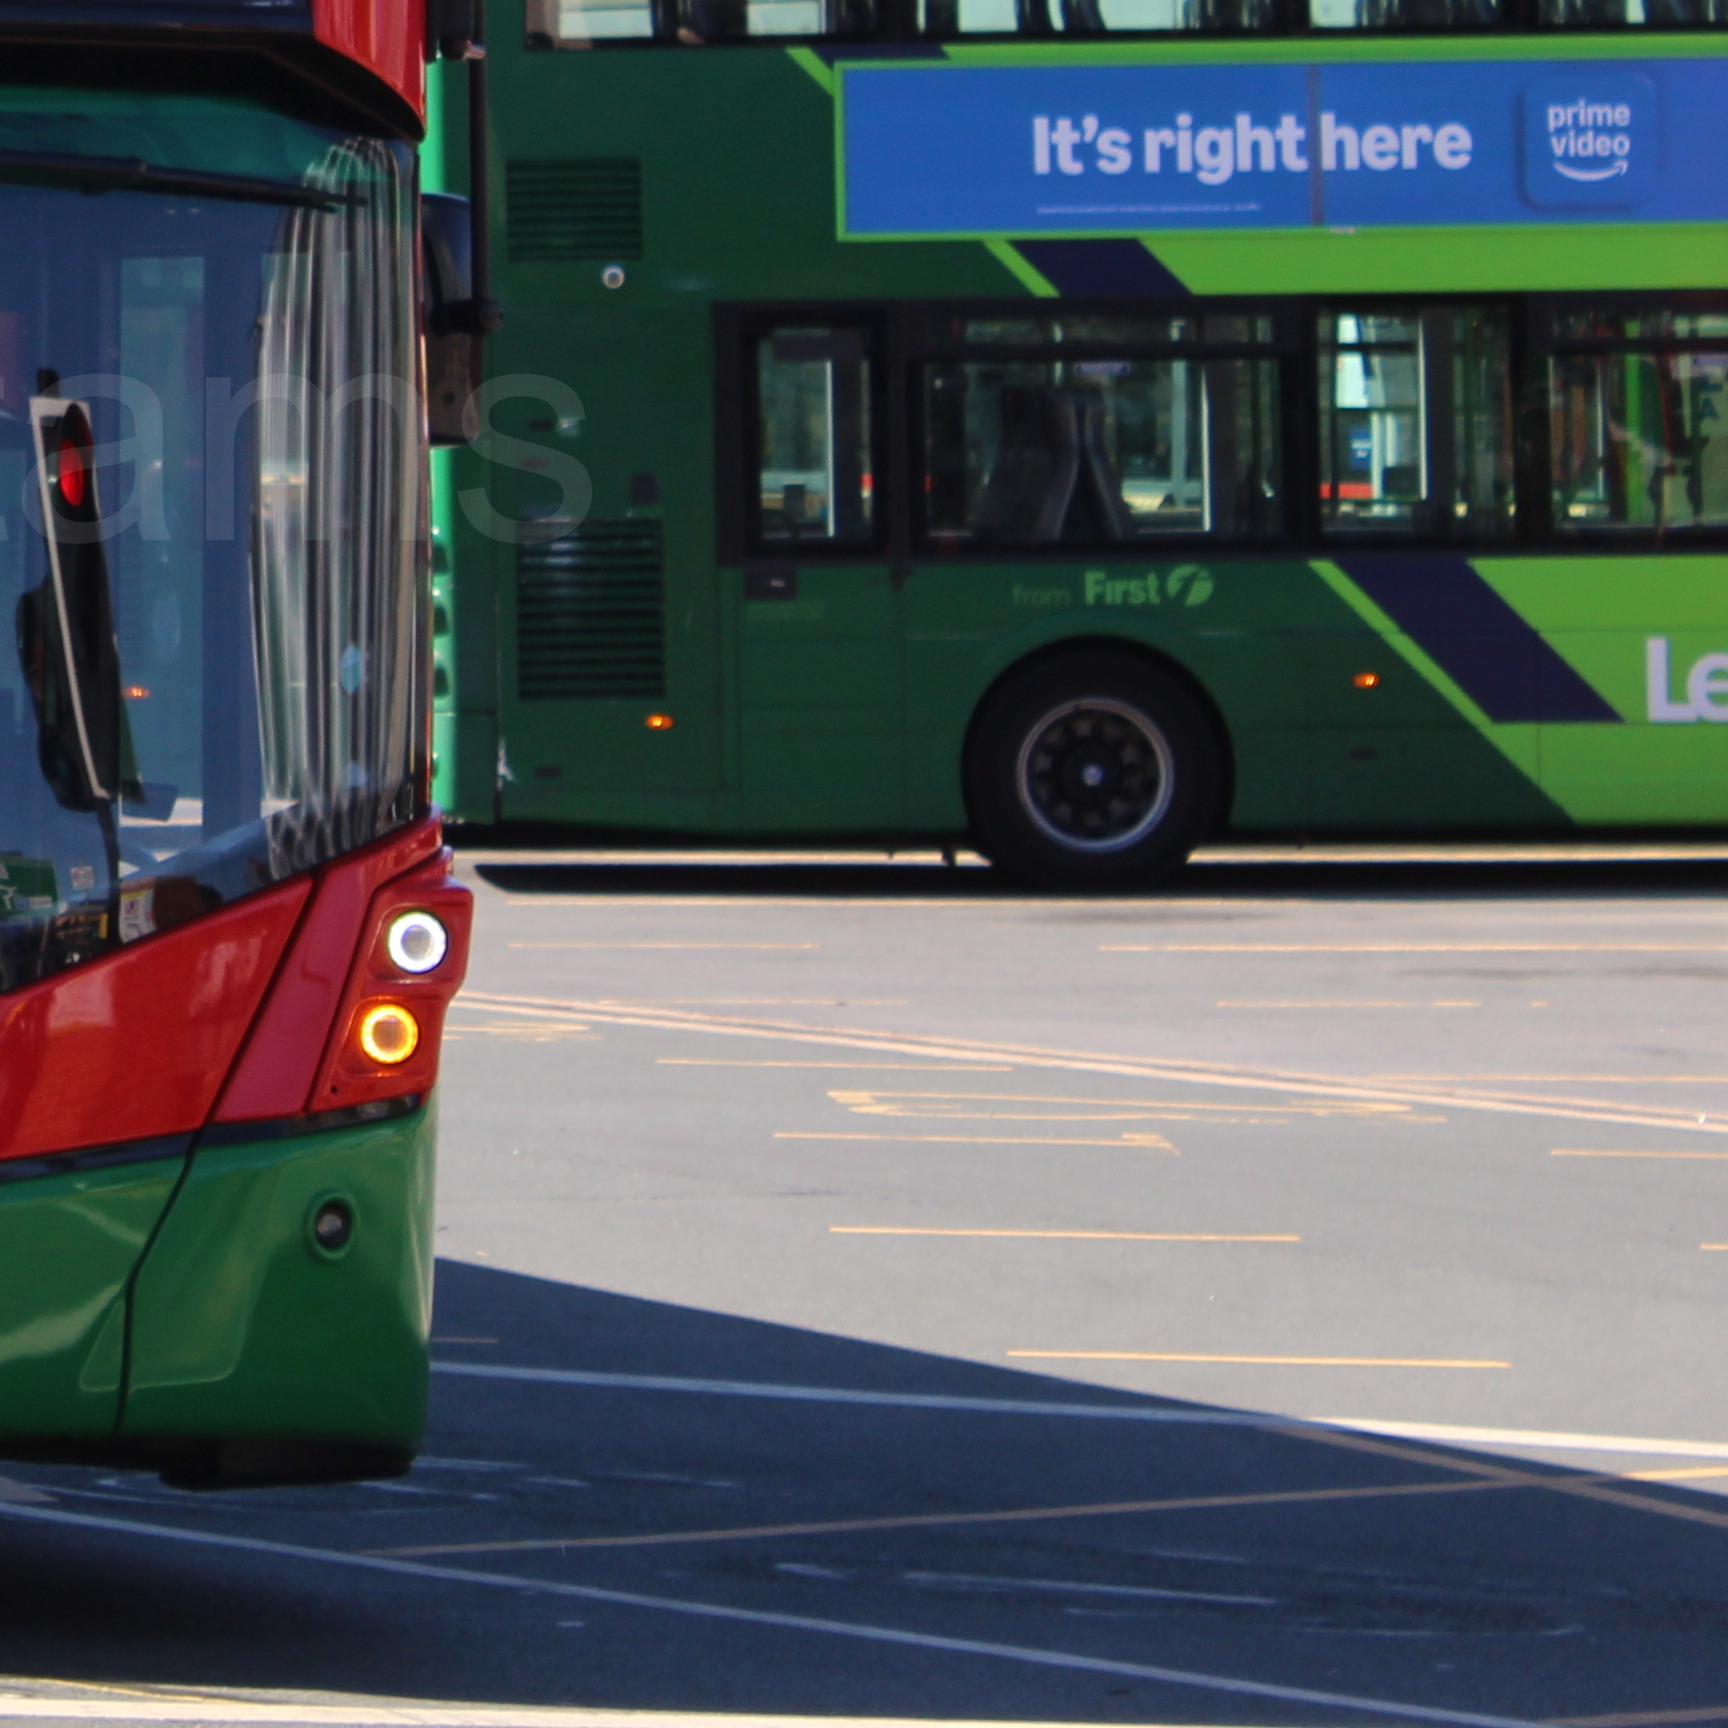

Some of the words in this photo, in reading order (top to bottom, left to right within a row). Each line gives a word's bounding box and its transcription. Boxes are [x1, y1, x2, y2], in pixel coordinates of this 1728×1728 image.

[1546, 98, 1631, 133] prime
[1033, 113, 1132, 175] It's
[1144, 112, 1308, 185] right
[1320, 111, 1473, 171] here
[1550, 129, 1631, 159] video
[1084, 571, 1161, 606] First
